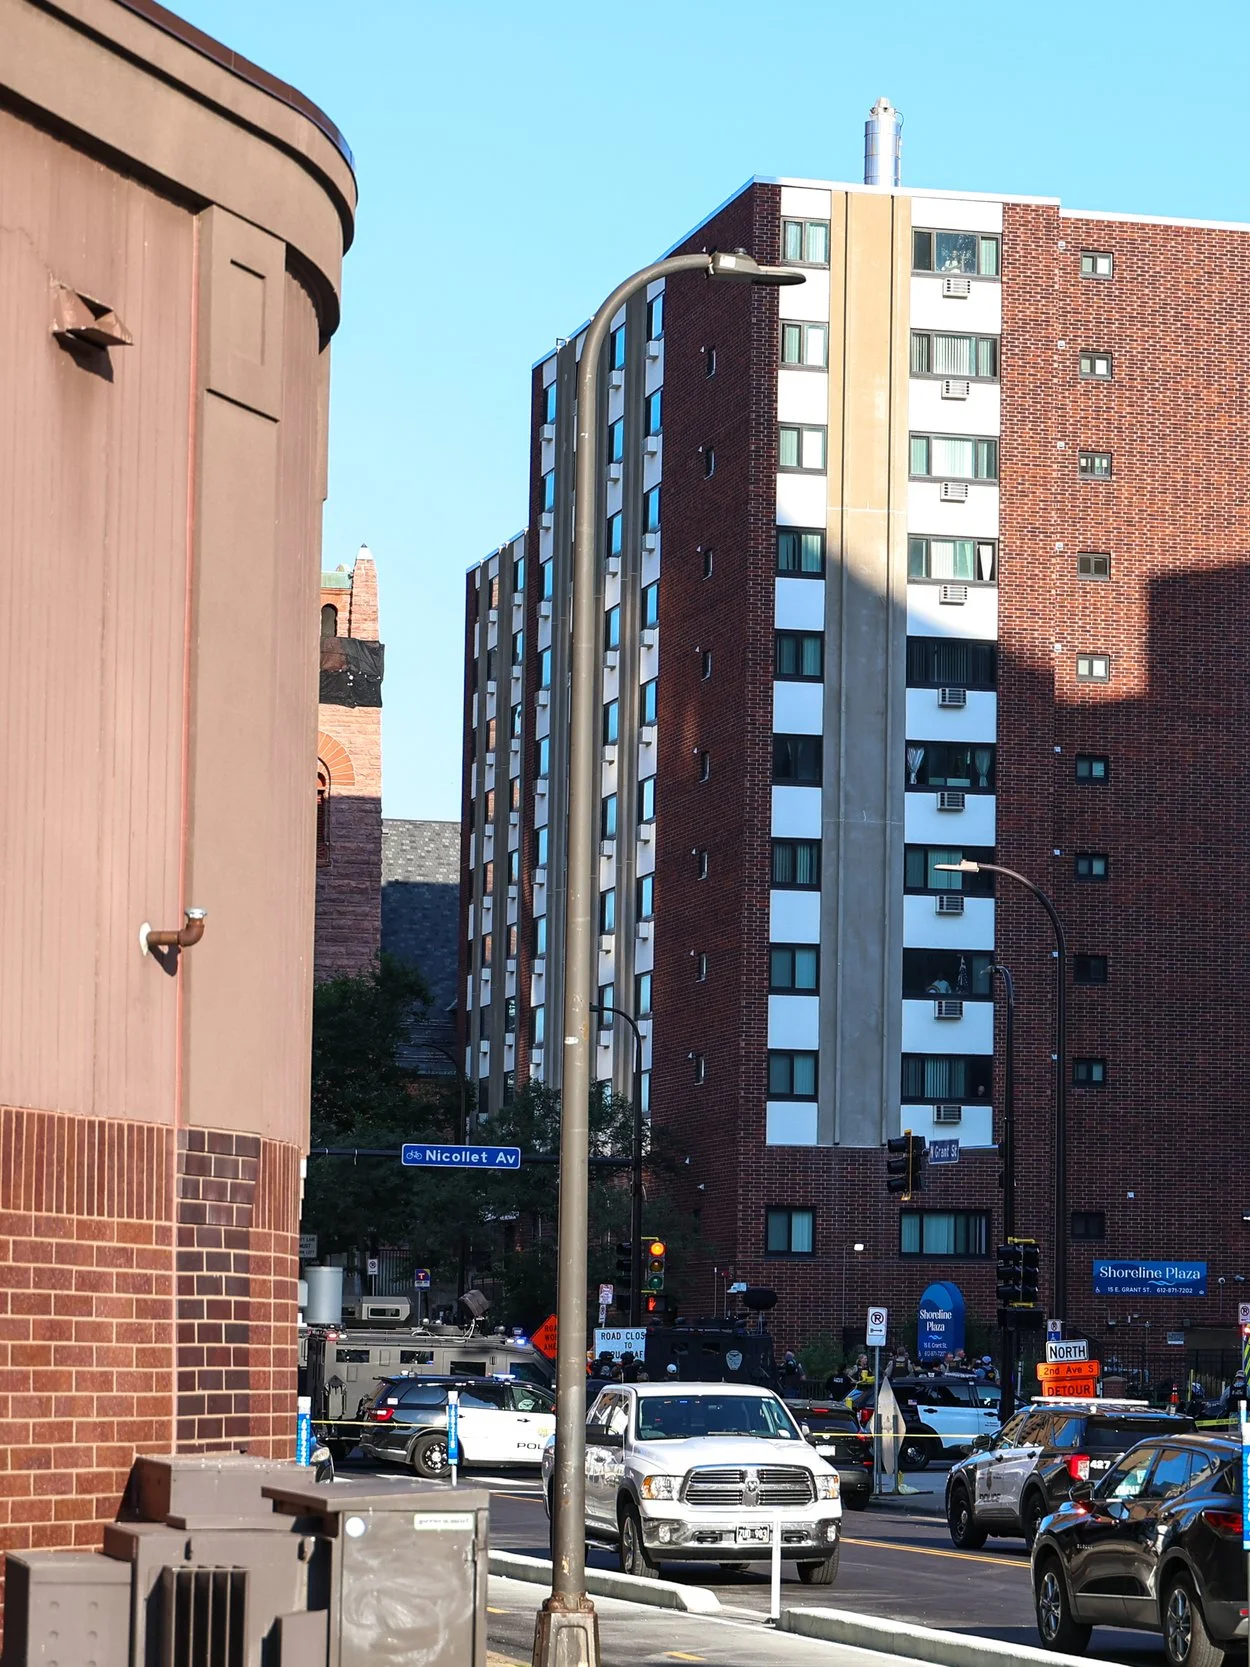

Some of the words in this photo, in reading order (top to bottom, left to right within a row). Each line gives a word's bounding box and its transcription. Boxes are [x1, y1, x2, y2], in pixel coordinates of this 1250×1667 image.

[425, 1149, 488, 1163] Nicollet
[495, 1151, 516, 1164] Av
[934, 1145, 950, 1158] Grant
[950, 1144, 958, 1157] St
[1099, 1265, 1162, 1279] Shoreline
[1165, 1267, 1200, 1280] Plaza
[919, 1308, 952, 1320] Shoreline
[926, 1321, 945, 1332] Plaza
[600, 1331, 621, 1340] ROAD
[625, 1331, 645, 1340] CLOS
[624, 1341, 633, 1349] TO
[1049, 1345, 1086, 1360] NORTH
[1043, 1367, 1060, 1375] 2nd
[1066, 1366, 1083, 1374] Ave
[1088, 1364, 1094, 1373] S
[1047, 1384, 1091, 1397] DETOUR
[516, 1442, 545, 1450] POL
[1090, 1460, 1111, 1469] 427
